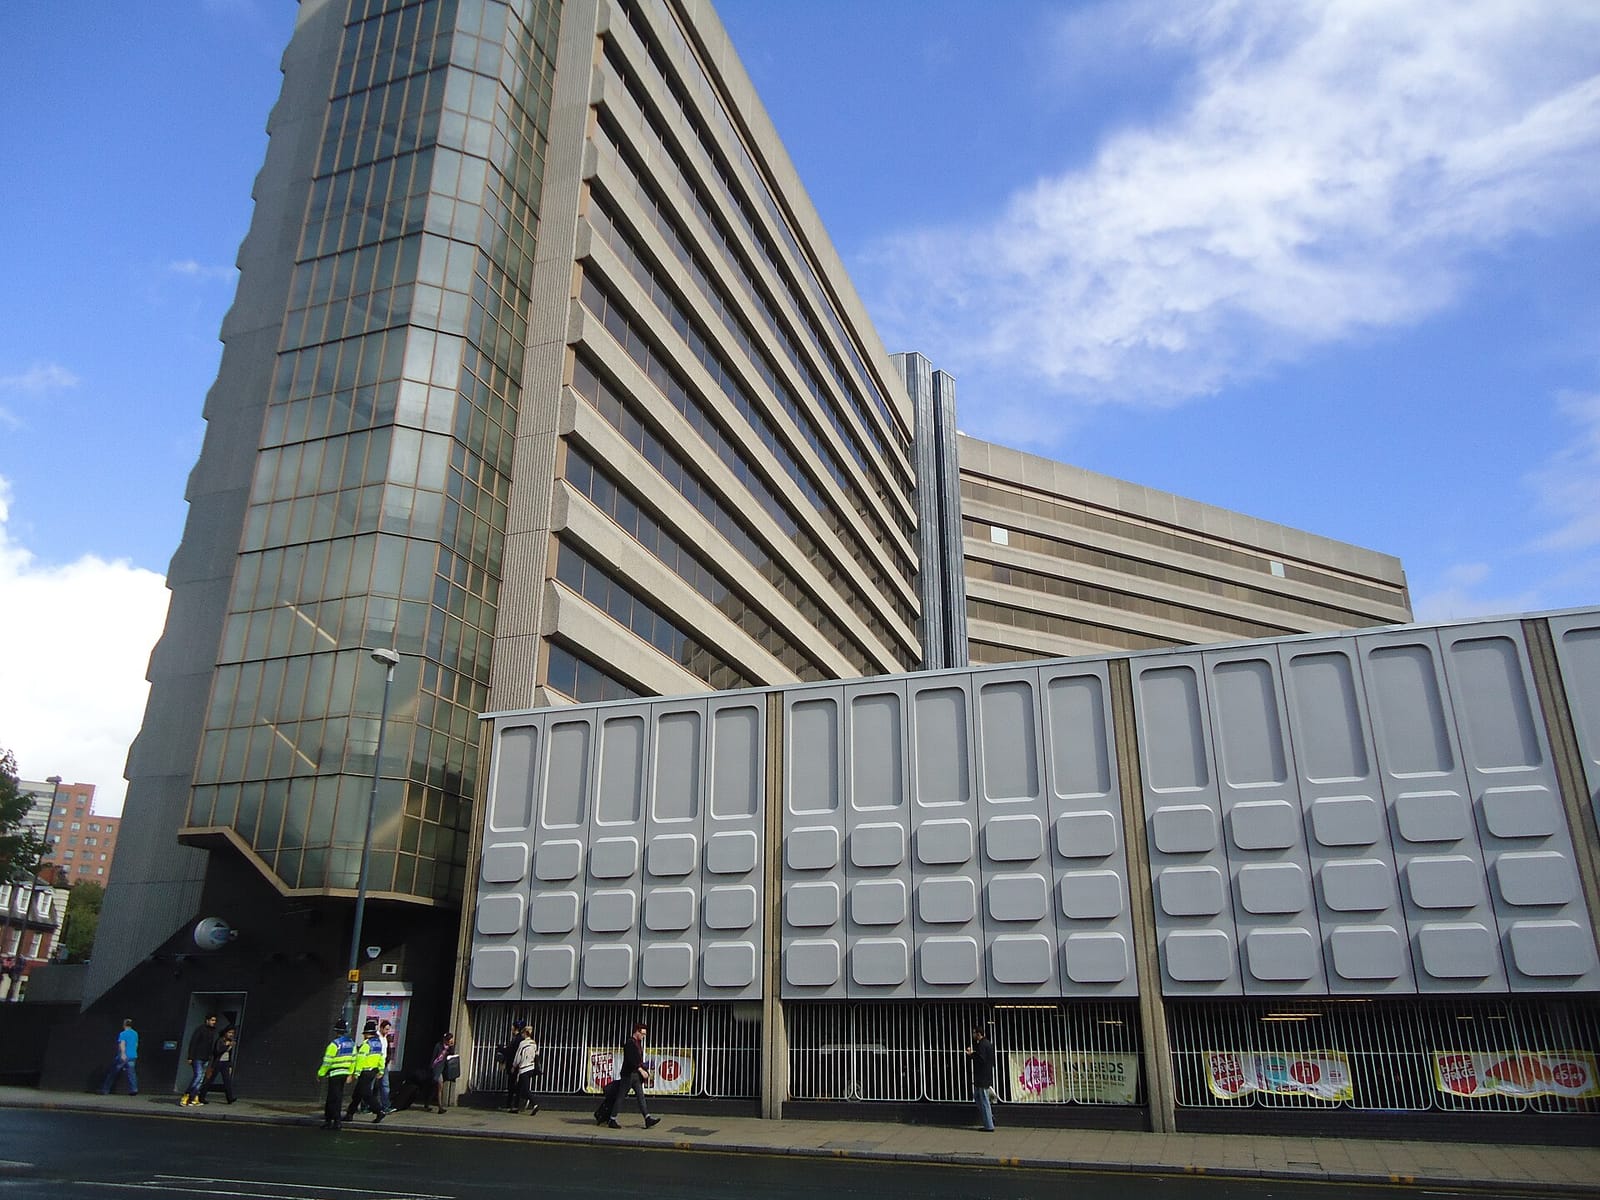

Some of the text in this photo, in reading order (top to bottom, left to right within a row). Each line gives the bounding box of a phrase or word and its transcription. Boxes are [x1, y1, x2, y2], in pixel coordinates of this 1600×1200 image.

[1064, 1062, 1124, 1074] IN LEEDS
[1440, 1059, 1472, 1073] HALF
[1443, 1068, 1476, 1082] PRICE
